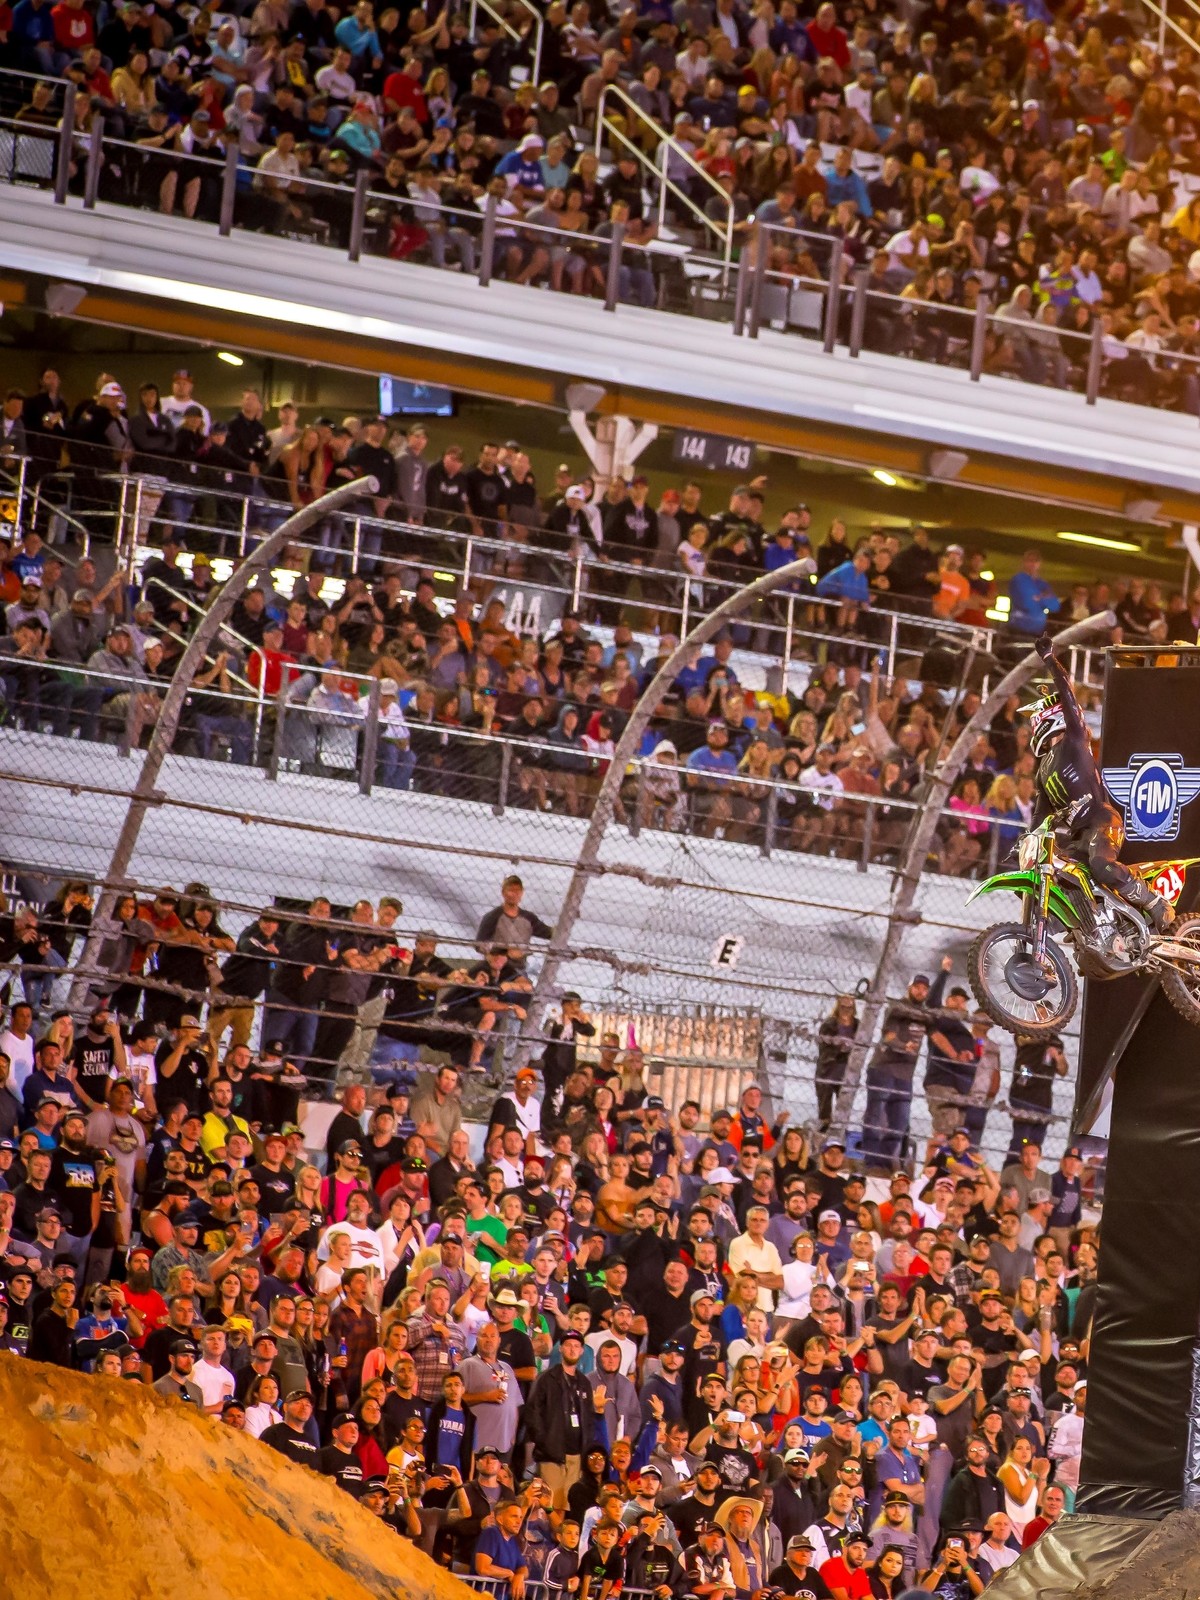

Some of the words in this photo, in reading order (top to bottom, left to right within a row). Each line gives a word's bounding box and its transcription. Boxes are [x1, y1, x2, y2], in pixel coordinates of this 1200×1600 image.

[681, 436, 706, 460] 144
[725, 444, 751, 469] 143
[1137, 780, 1171, 814] FIM
[1156, 869, 1184, 900] 24
[718, 939, 736, 963] E
[83, 1050, 110, 1063] SAFETY
